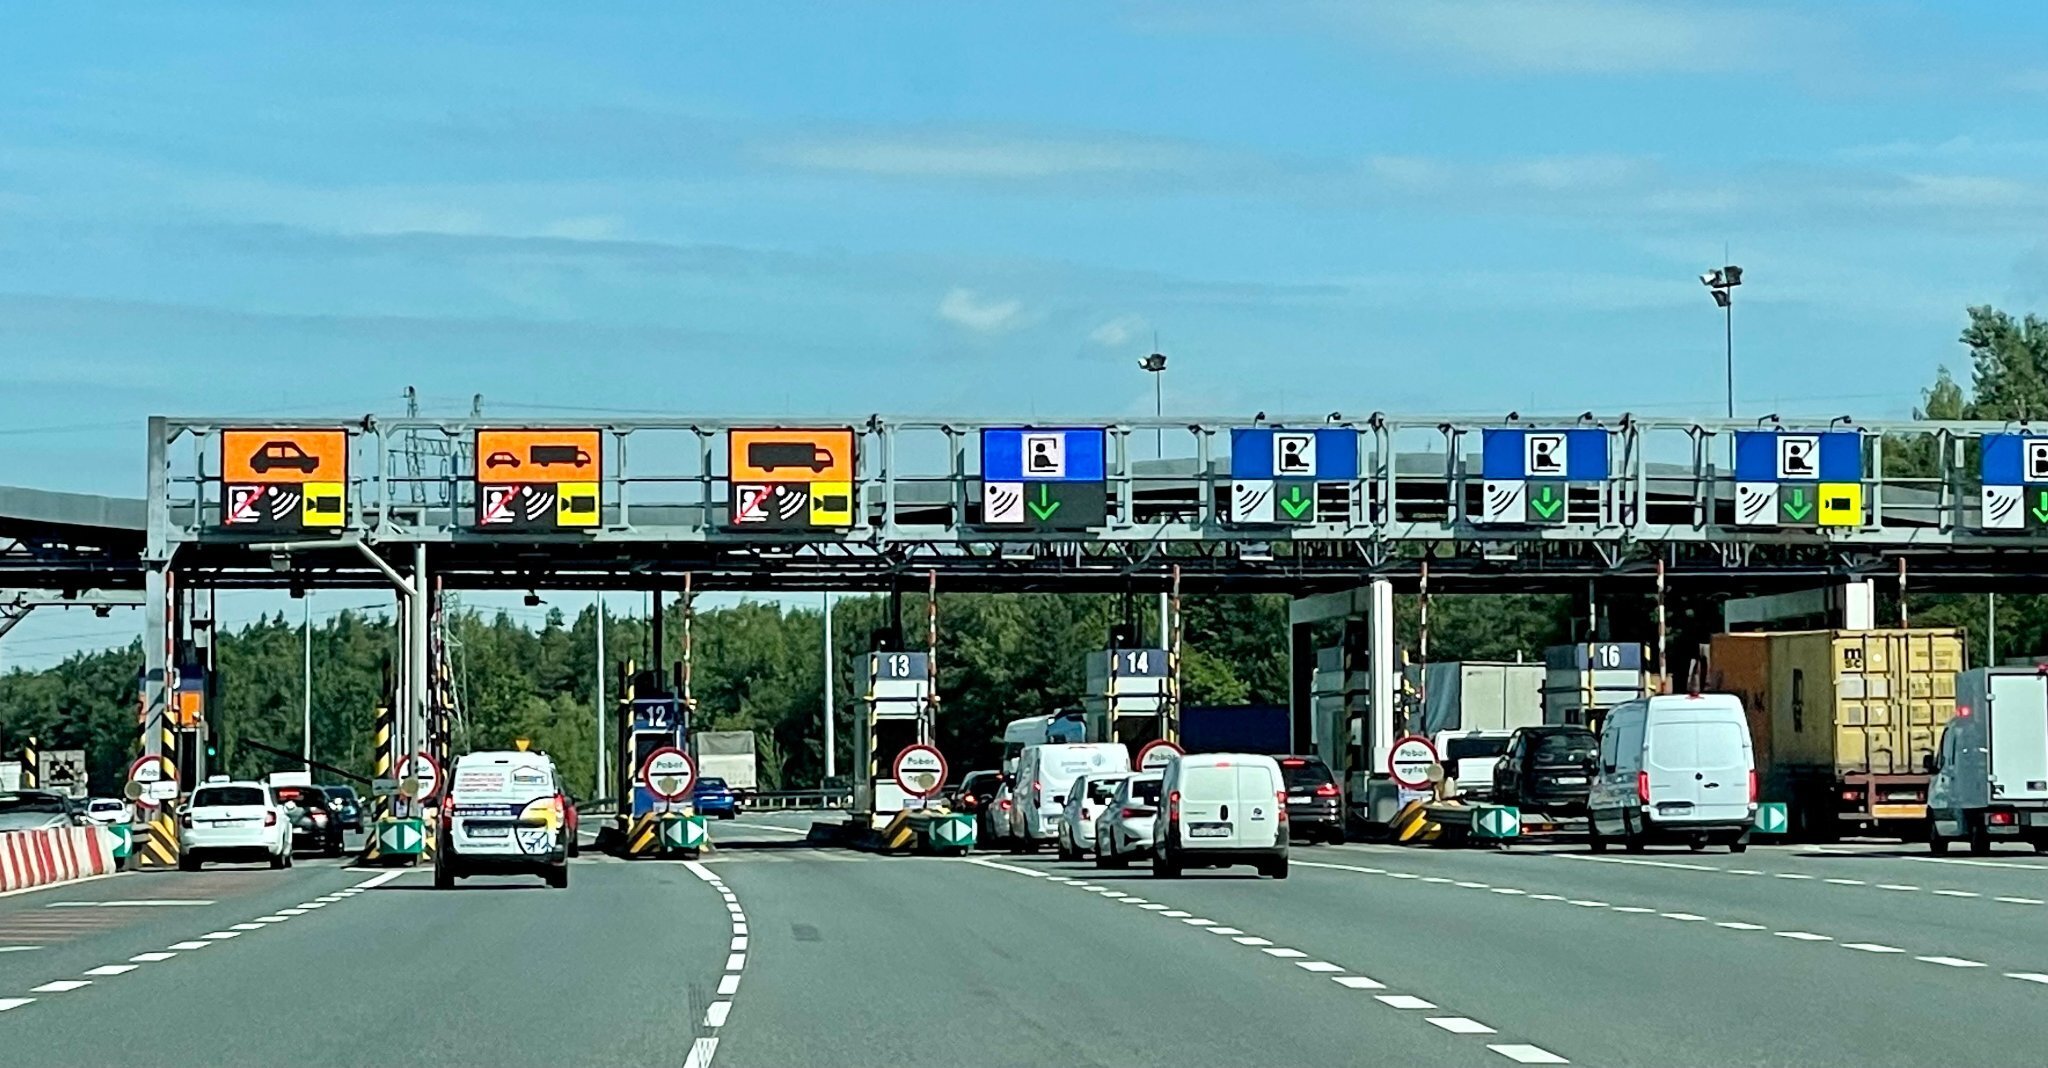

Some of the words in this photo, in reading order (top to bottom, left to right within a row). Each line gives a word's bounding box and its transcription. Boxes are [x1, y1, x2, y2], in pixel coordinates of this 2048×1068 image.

[888, 654, 910, 677] 13
[1126, 651, 1149, 674] 14
[1600, 645, 1620, 668] 16
[646, 705, 667, 727] 12
